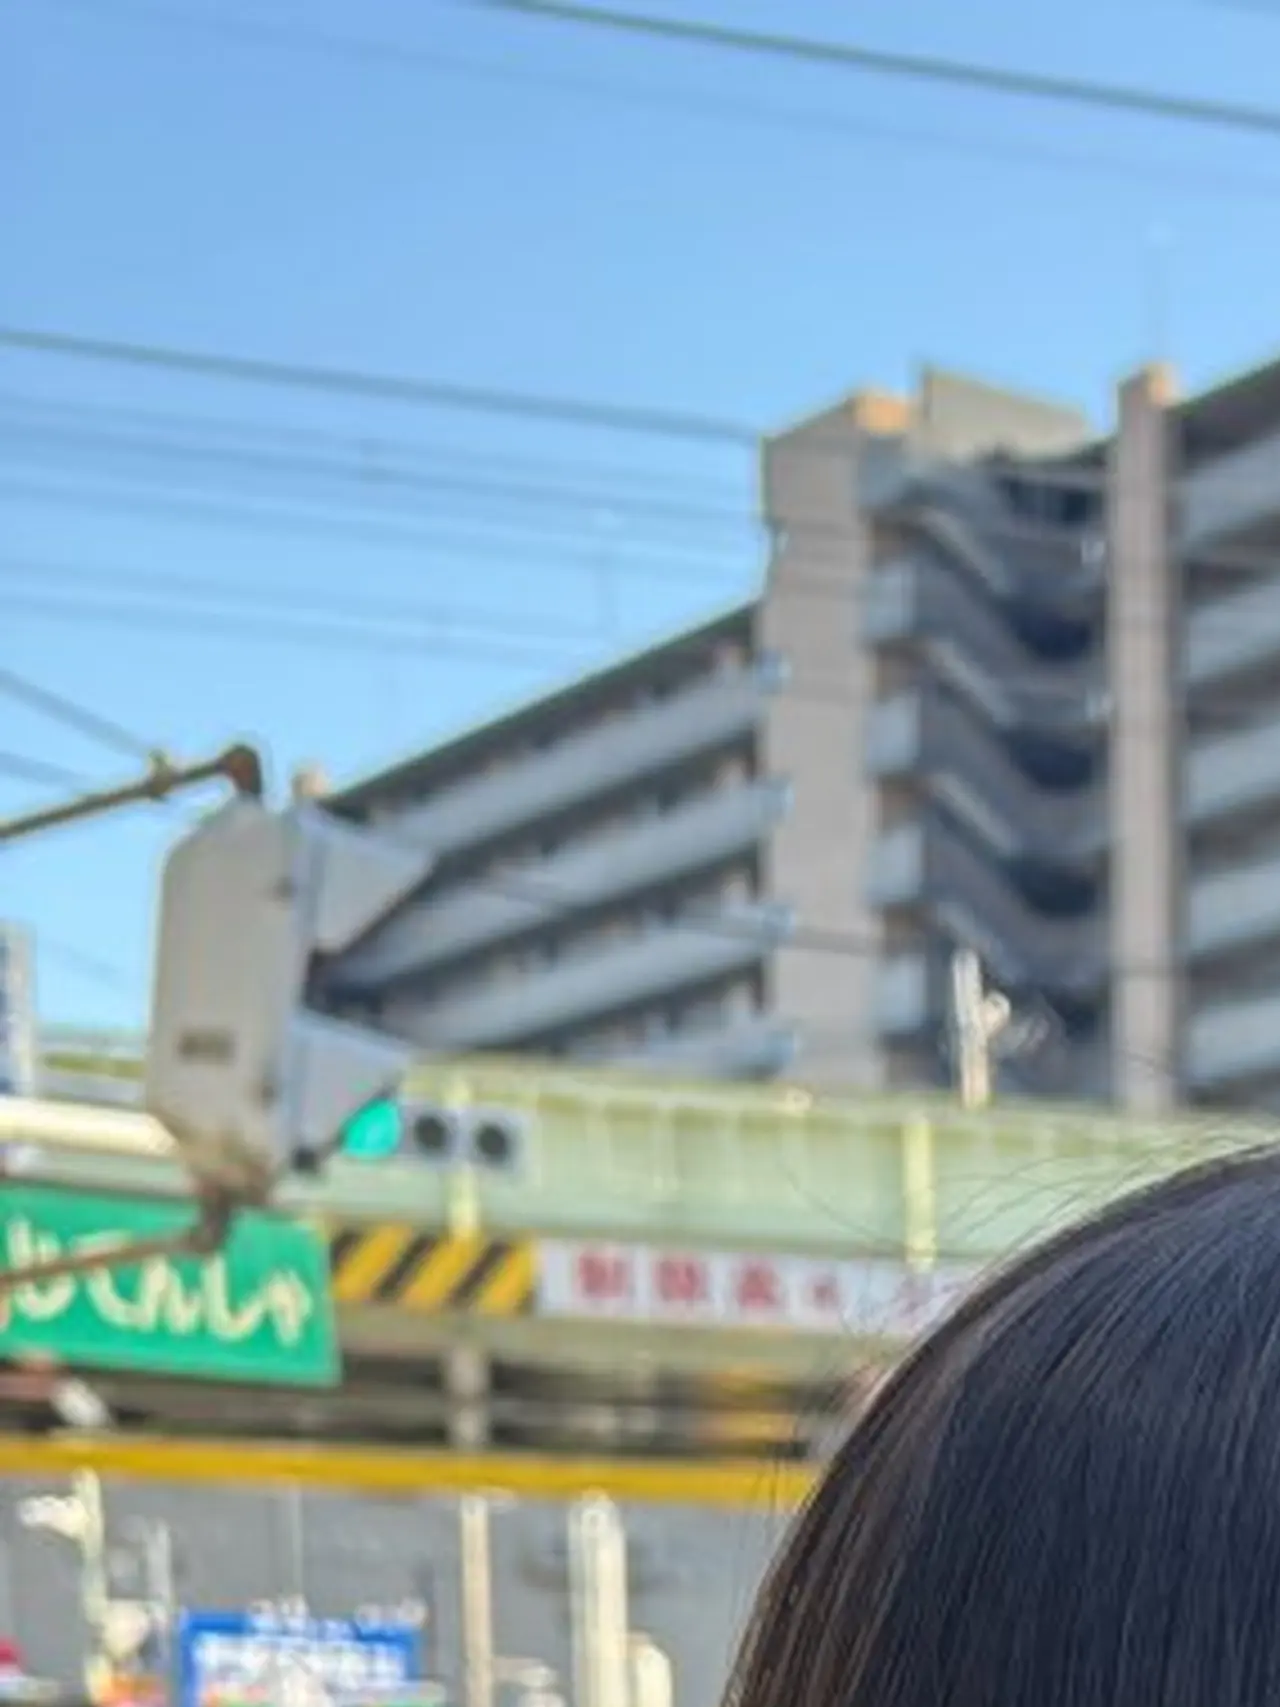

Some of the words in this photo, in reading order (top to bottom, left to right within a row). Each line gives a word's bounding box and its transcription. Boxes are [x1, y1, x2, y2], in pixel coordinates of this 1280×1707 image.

[0, 1213, 314, 1347] じてんしゃ
